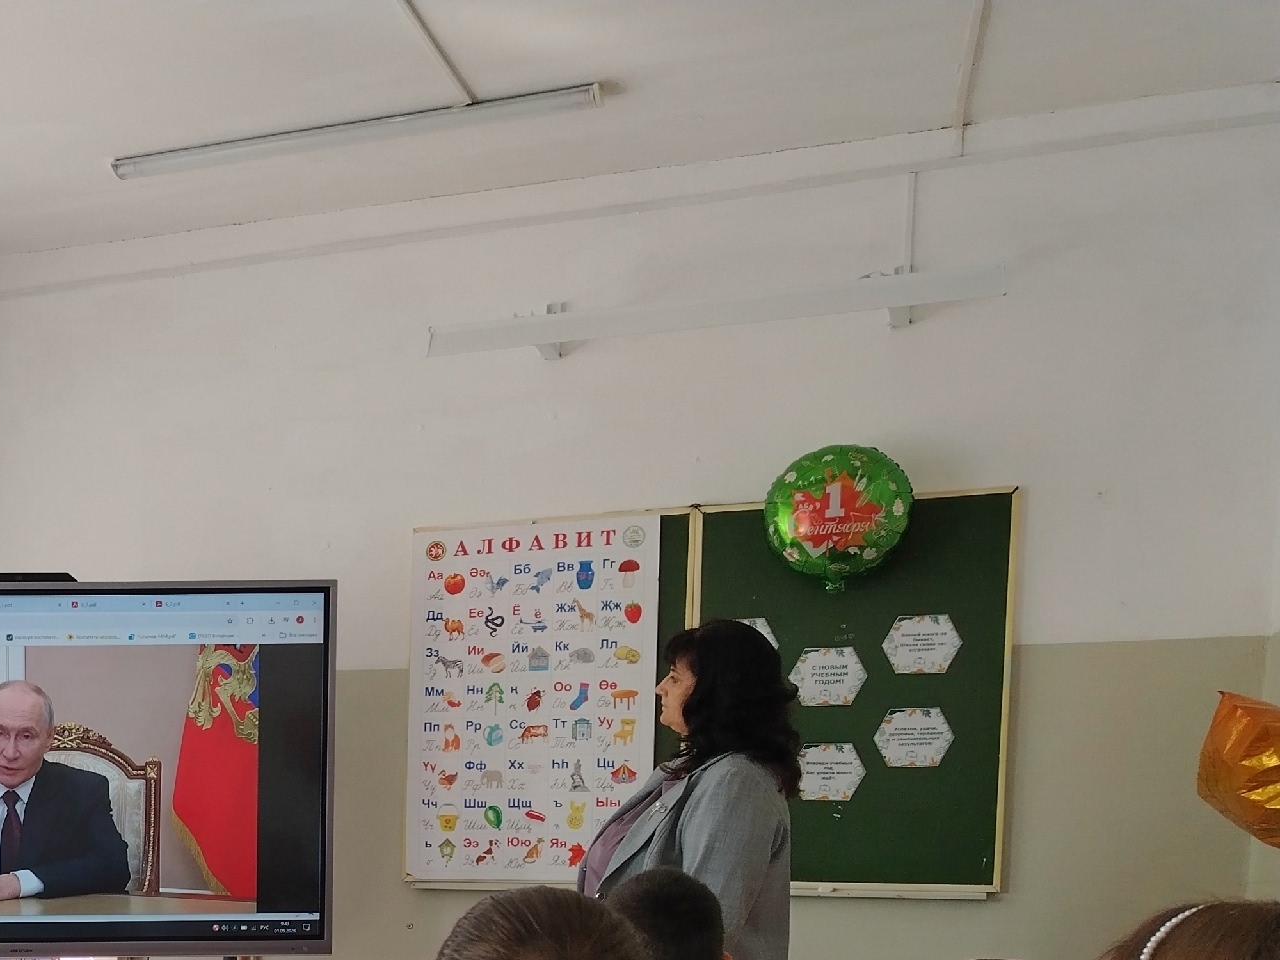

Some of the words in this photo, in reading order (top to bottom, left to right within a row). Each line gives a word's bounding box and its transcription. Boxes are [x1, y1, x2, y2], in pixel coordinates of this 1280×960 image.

[825, 482, 844, 518] 1
[428, 570, 444, 580] Аа
[514, 564, 531, 575] Бб
[557, 562, 574, 572] Вв
[603, 558, 616, 569] Гг
[426, 610, 443, 622] Дд
[469, 608, 484, 618] Ее
[513, 604, 520, 616] Ё
[534, 608, 542, 618] ё
[556, 603, 576, 613] Жж
[426, 648, 439, 658] Зз
[468, 646, 484, 656] Ии
[512, 641, 528, 653] Йй
[555, 641, 570, 651] Кк
[600, 639, 618, 649] Лл
[425, 687, 444, 697] Мм
[467, 686, 483, 695] Нн
[553, 682, 572, 692] Оо
[424, 723, 440, 732] Пп
[466, 721, 482, 733] Рр
[510, 720, 525, 730] Сс
[553, 719, 567, 728] Тт
[598, 717, 613, 729] Уу
[465, 760, 486, 772] Фф
[508, 760, 524, 769] Хх
[597, 758, 615, 770] Цц
[422, 798, 437, 808] Чч
[464, 799, 486, 808] Шш
[508, 798, 532, 809] Щщ
[596, 798, 620, 807] Ыы
[463, 838, 479, 848] Ээ
[508, 837, 531, 847] Юю
[550, 838, 566, 848] Яя
